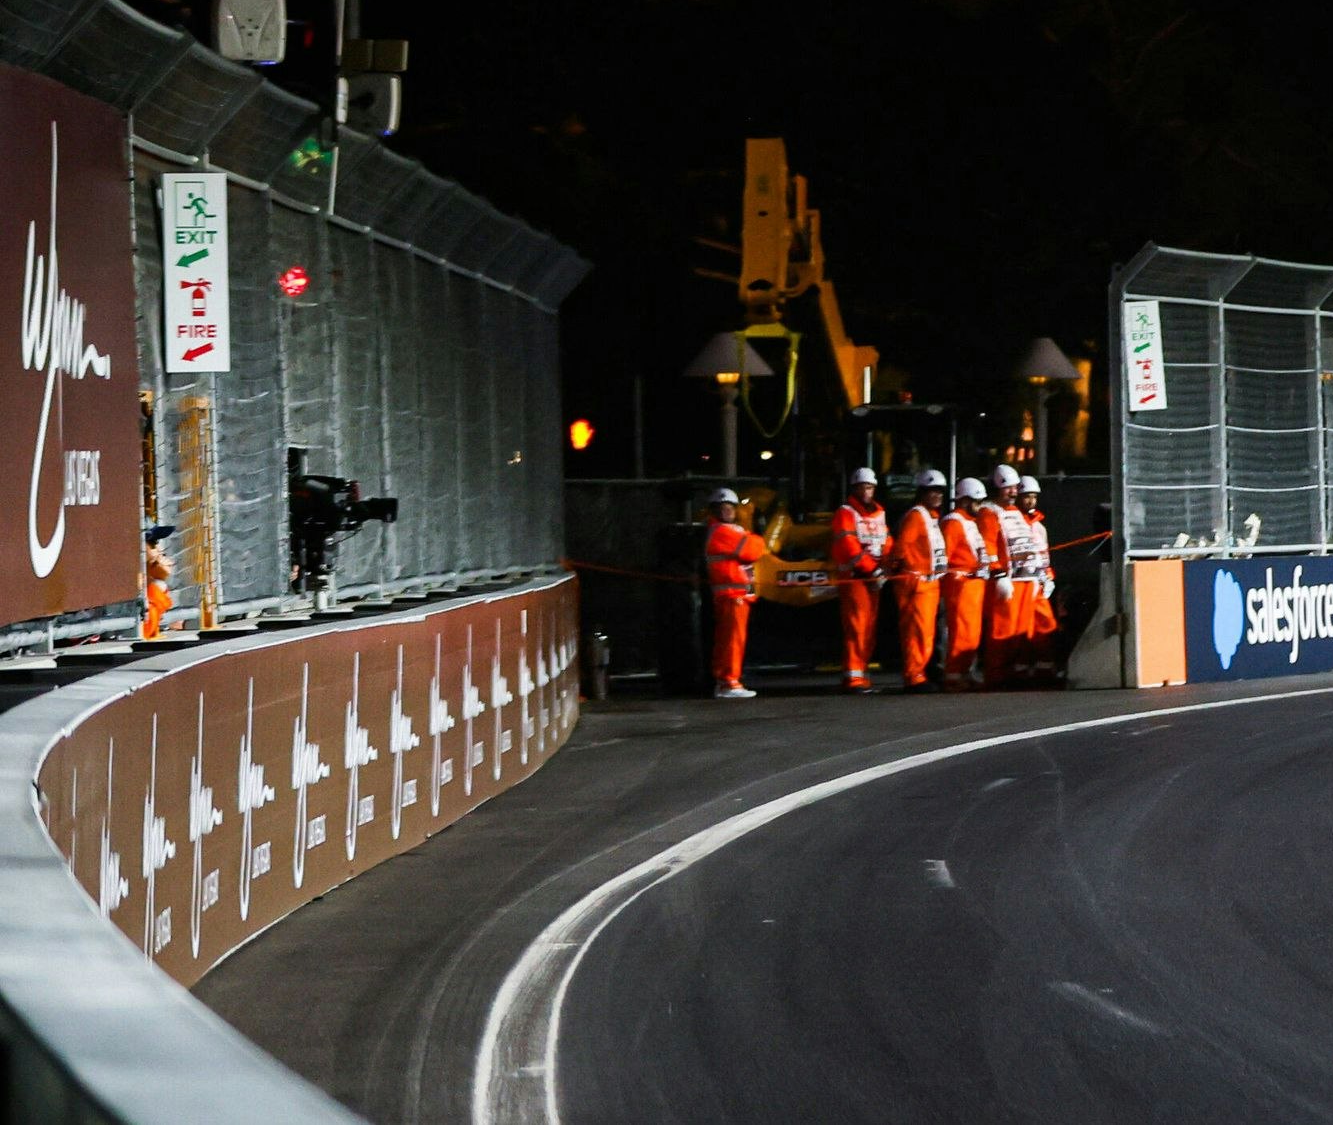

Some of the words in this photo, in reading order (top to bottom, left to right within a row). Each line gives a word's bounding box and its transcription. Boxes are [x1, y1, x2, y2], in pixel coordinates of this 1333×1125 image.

[175, 230, 218, 245] EXIT
[177, 324, 217, 339] FIRE
[1132, 331, 1156, 342] EXIT
[1135, 382, 1158, 393] FIRE
